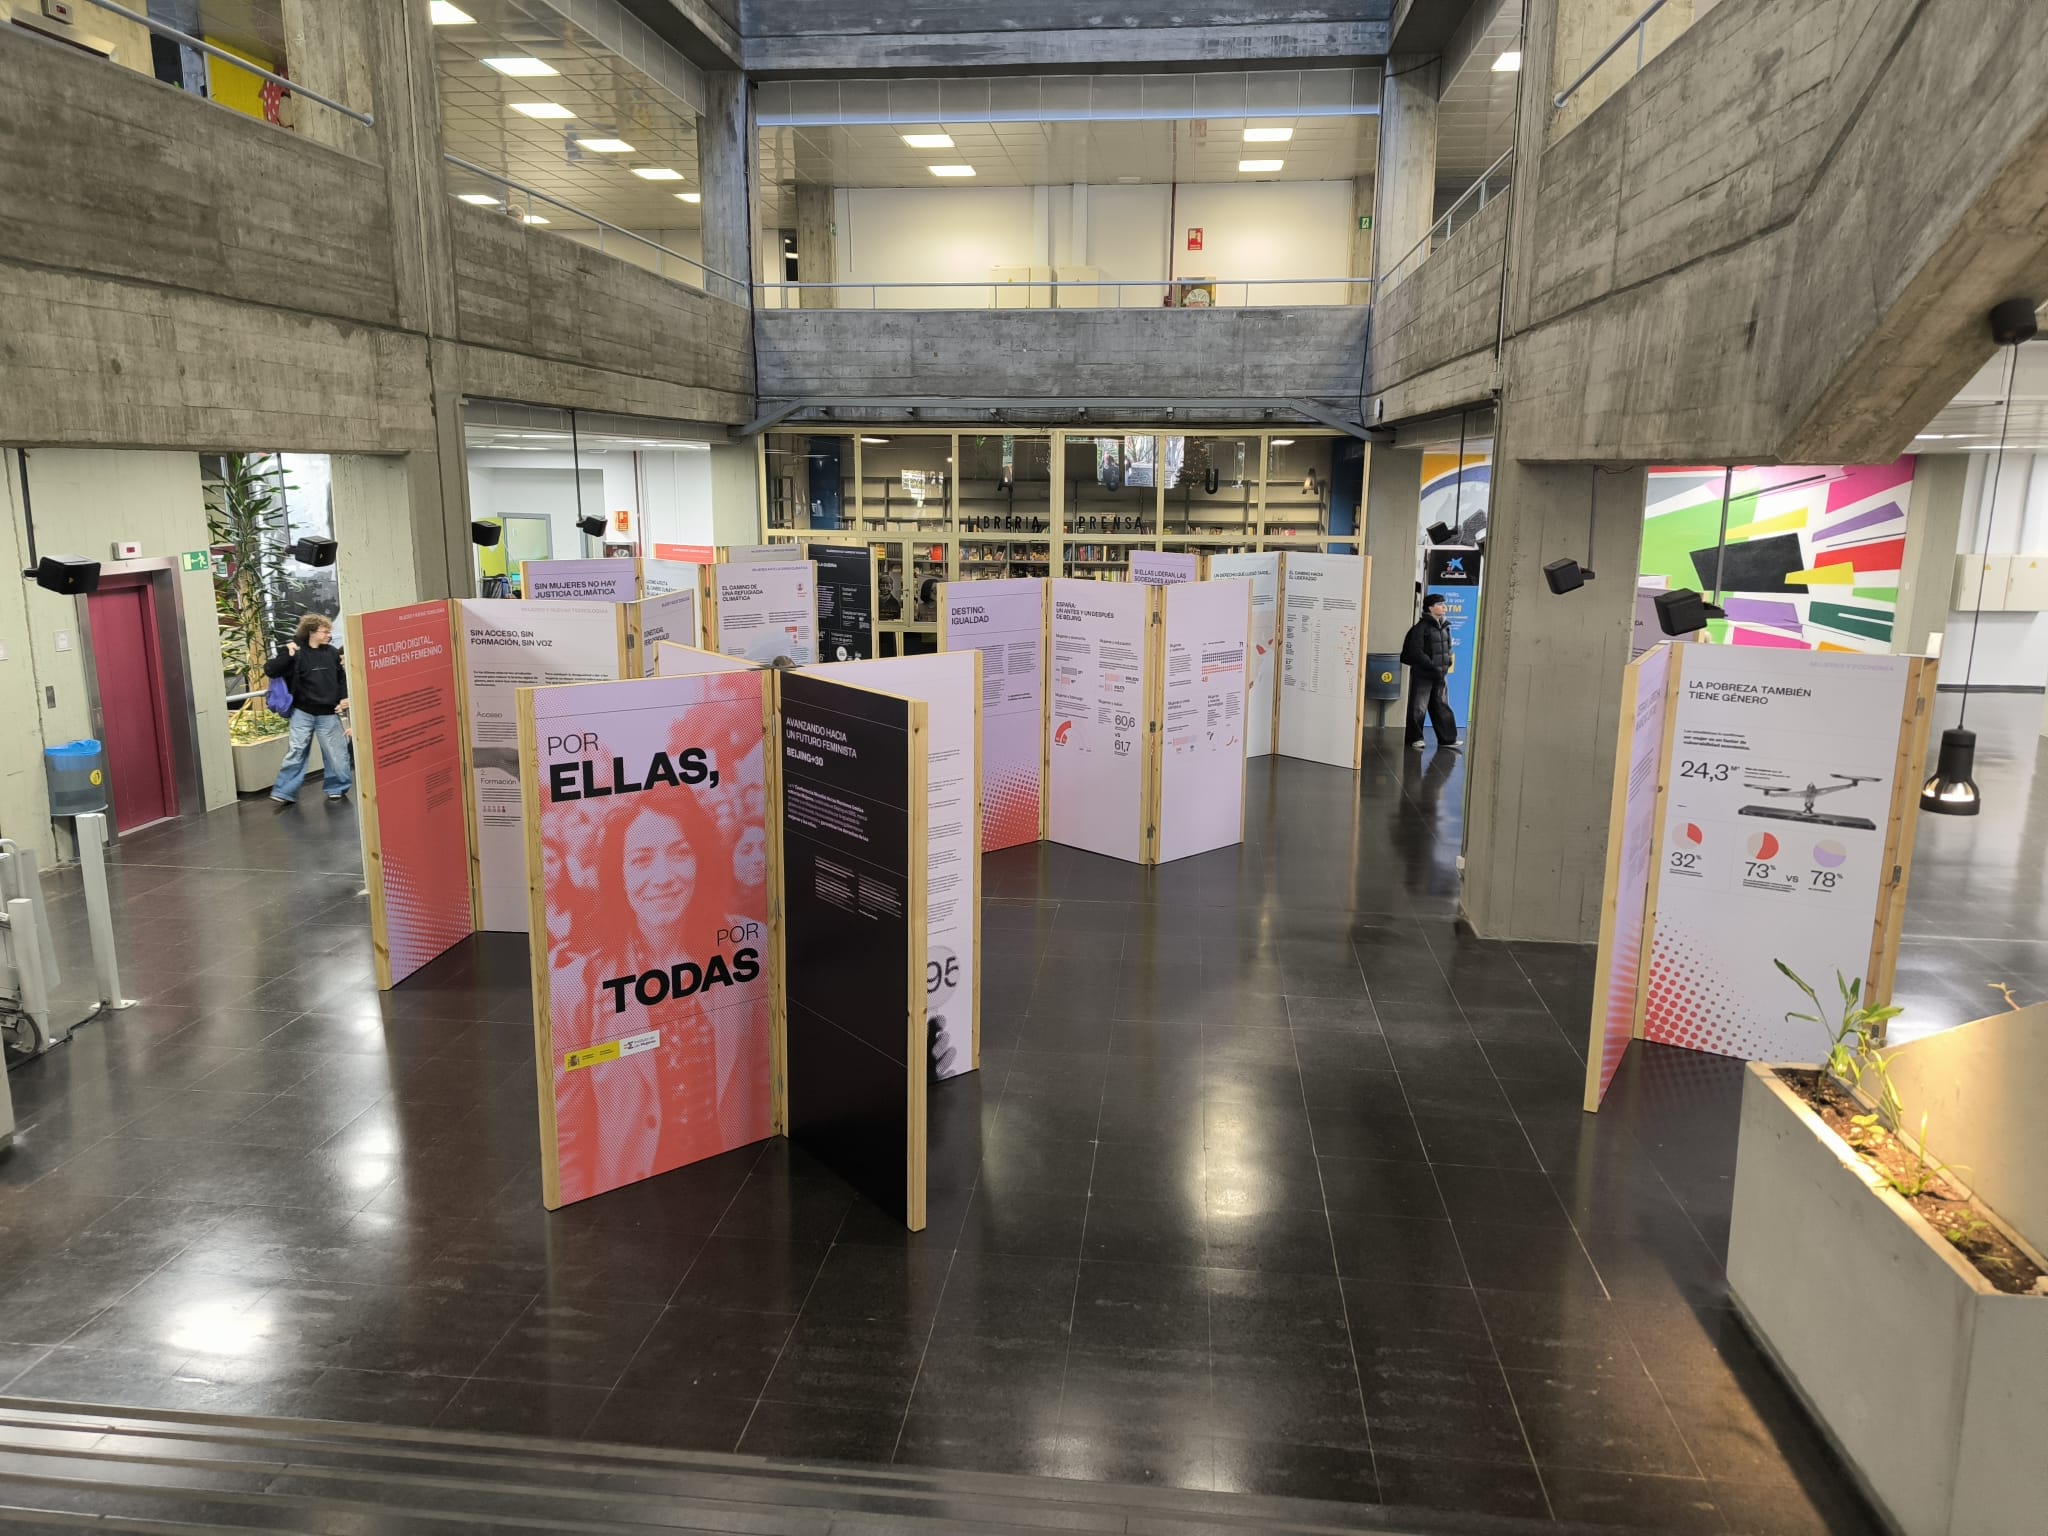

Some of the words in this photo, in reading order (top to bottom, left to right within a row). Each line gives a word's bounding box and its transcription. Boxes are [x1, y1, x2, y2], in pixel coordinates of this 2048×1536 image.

[967, 515, 1040, 531] LIBRERIA
[1078, 516, 1143, 530] PRENSA
[1134, 576, 1164, 584] SOCIEDADES
[1154, 570, 1176, 579] LIDERAN,
[534, 582, 548, 590] SIN
[549, 581, 587, 589] MUJERES
[588, 580, 600, 588] NO
[535, 590, 572, 598] JUSTICIA
[573, 588, 616, 597] CLIMÁTICA
[951, 606, 986, 616] DESTINO:
[1056, 601, 1076, 609] ESPAÑA:
[951, 616, 990, 626] IGUALDAD
[1062, 614, 1082, 622] BEIJING
[1091, 611, 1114, 619] DESPUÉS
[470, 629, 484, 637] SIN
[484, 630, 520, 638] ACCESO,
[520, 630, 534, 638] SIN
[368, 647, 378, 658] EL
[378, 640, 407, 655] FUTURO
[407, 635, 434, 649] DIGITAL,
[471, 637, 521, 647] FORMACIÓN,
[401, 652, 410, 663] EN
[410, 645, 443, 660] FEMENINO
[1689, 680, 1704, 689] LA
[1706, 682, 1758, 694] POBREZA
[1761, 685, 1812, 698] TAMBIÉN
[1688, 691, 1720, 701] TIENE
[1722, 692, 1769, 705] GÉNERO
[1114, 714, 1136, 729] 60,6
[786, 716, 826, 736] AVANZANDO
[826, 728, 848, 743] HACIA
[548, 732, 599, 756] POR
[786, 729, 796, 740] UN
[796, 732, 822, 748] FUTURO
[822, 740, 858, 759] FEMINISTA
[1114, 740, 1132, 753] 61,7
[786, 746, 824, 767] BEIJING+30
[550, 747, 720, 803] ELLAS,
[1680, 760, 1730, 783] 24,3
[717, 922, 760, 947] POR
[602, 947, 760, 1014] TODAS
